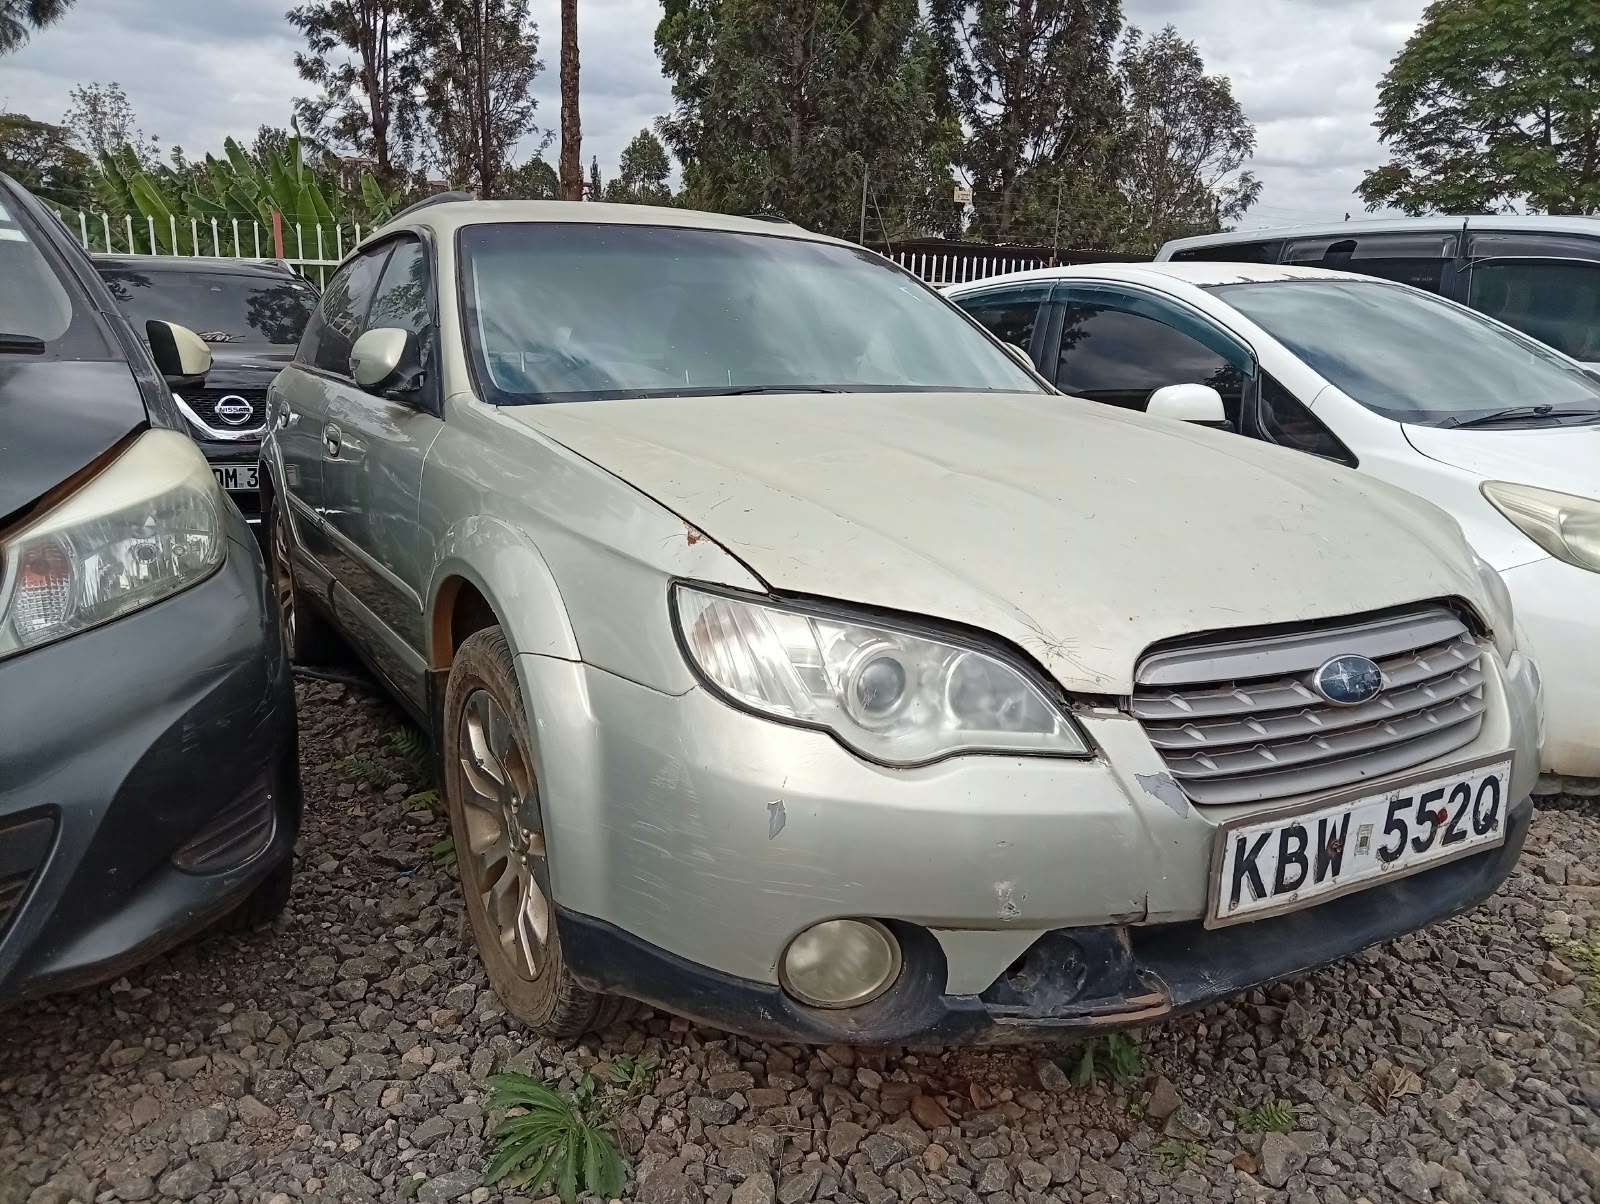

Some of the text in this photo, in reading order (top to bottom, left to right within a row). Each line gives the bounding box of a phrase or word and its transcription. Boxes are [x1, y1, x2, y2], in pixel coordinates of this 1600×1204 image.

[219, 406, 251, 414] NISSAN
[1228, 774, 1501, 912] KBW 552Q
